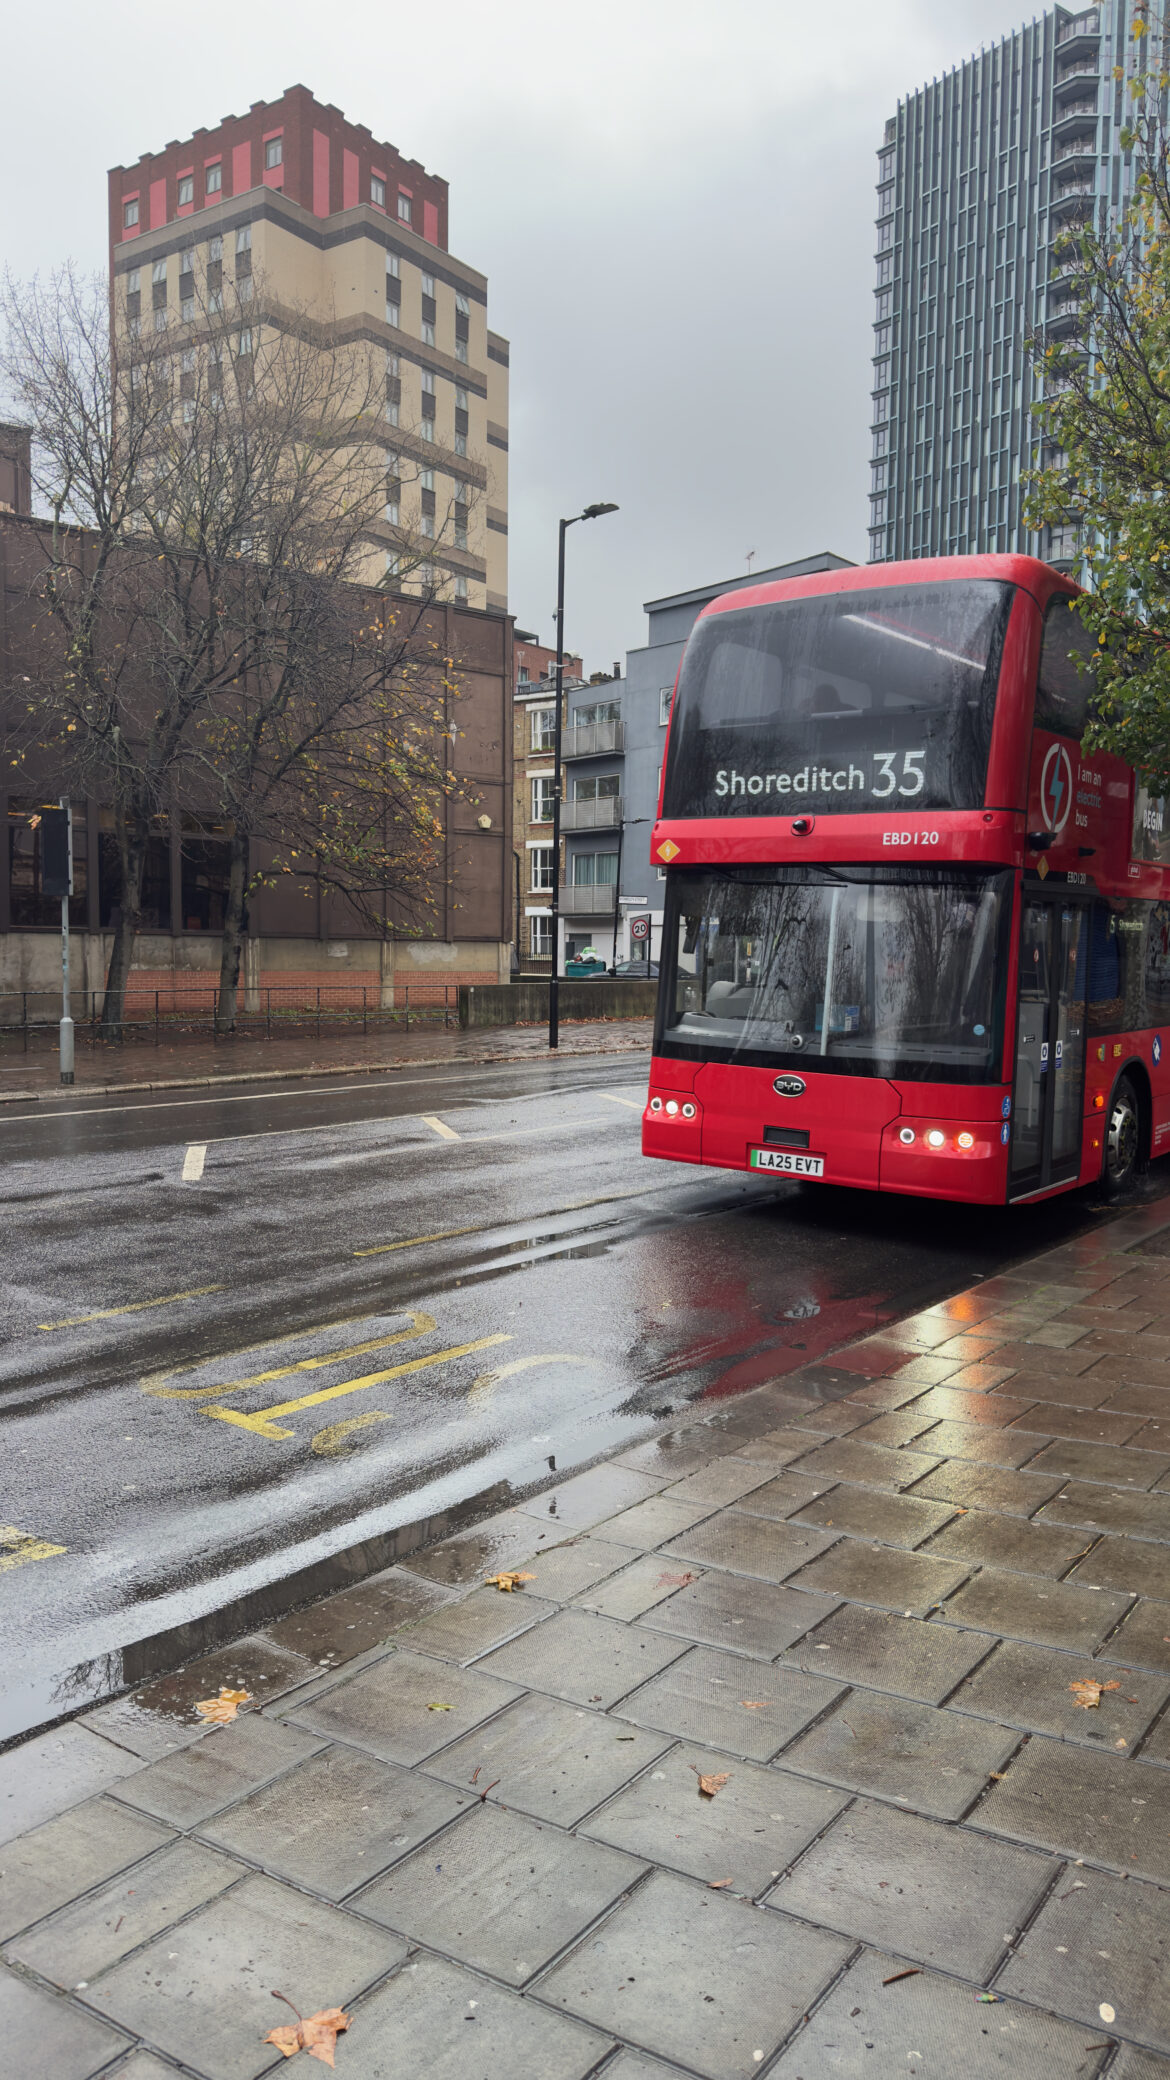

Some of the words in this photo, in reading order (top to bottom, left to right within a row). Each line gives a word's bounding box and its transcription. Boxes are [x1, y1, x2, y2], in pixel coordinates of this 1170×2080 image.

[715, 765, 864, 796] Shoreditch
[871, 750, 926, 797] 35
[1077, 764, 1081, 781] I
[1082, 769, 1092, 784] am
[1093, 772, 1102, 787] an
[1076, 787, 1102, 808] electric
[1075, 809, 1088, 827] bus
[1143, 809, 1163, 831] BEGIN
[882, 831, 939, 845] EBD120
[1067, 871, 1086, 884] EBD120
[635, 924, 646, 933] 20
[776, 1080, 802, 1091] BYD
[759, 1152, 792, 1169] LA25
[795, 1158, 821, 1173] EVT
